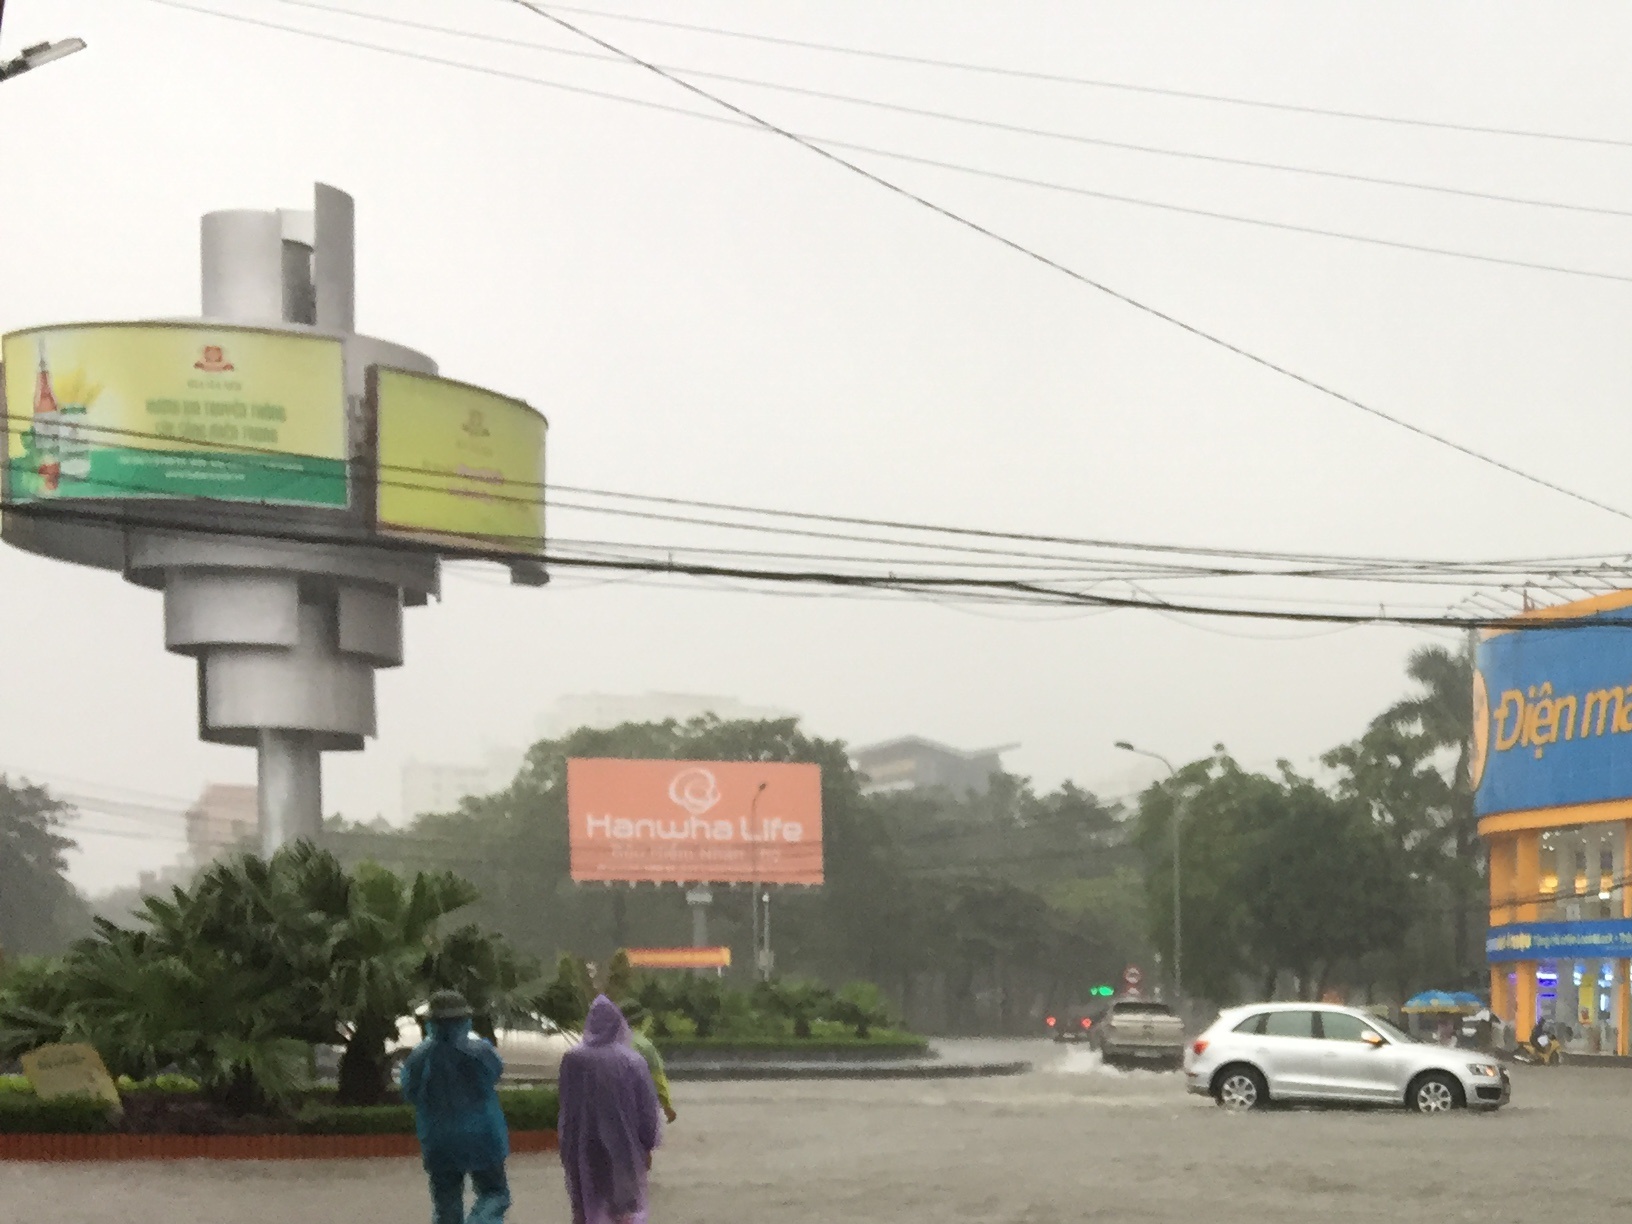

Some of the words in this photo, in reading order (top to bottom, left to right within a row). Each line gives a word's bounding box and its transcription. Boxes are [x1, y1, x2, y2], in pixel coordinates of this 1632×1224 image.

[1494, 681, 1577, 759] Điện
[586, 813, 734, 841] Hanwha
[740, 816, 803, 842] Life
